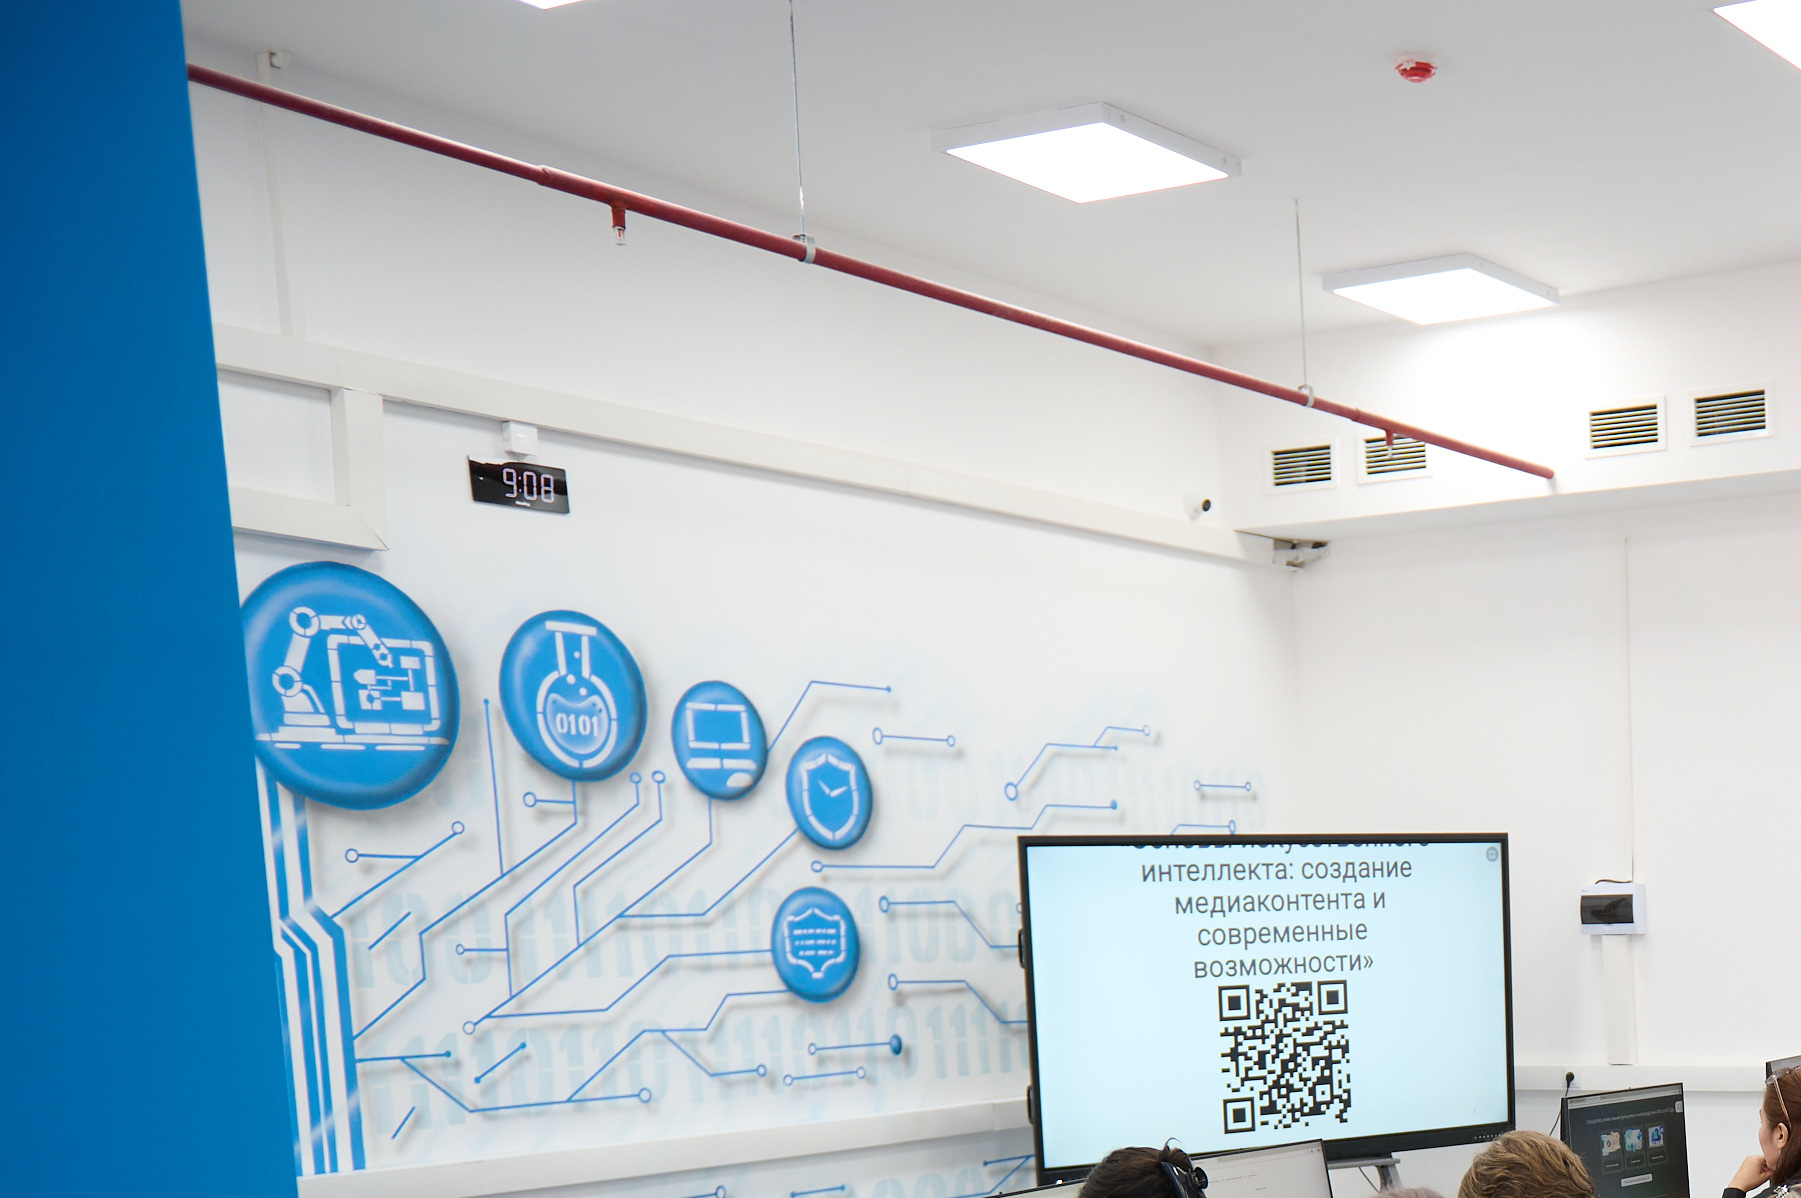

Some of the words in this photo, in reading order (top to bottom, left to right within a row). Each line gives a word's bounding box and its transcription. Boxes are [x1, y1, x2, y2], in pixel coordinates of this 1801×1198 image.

[502, 467, 555, 503] 9:08
[556, 712, 598, 737] 0101
[1141, 862, 1293, 882] интеллекта:
[1302, 859, 1412, 883] создание
[1175, 892, 1365, 917] медиаконтента
[1373, 892, 1385, 909] и
[1198, 922, 1368, 950] современные
[1194, 954, 1374, 978] возможности»
